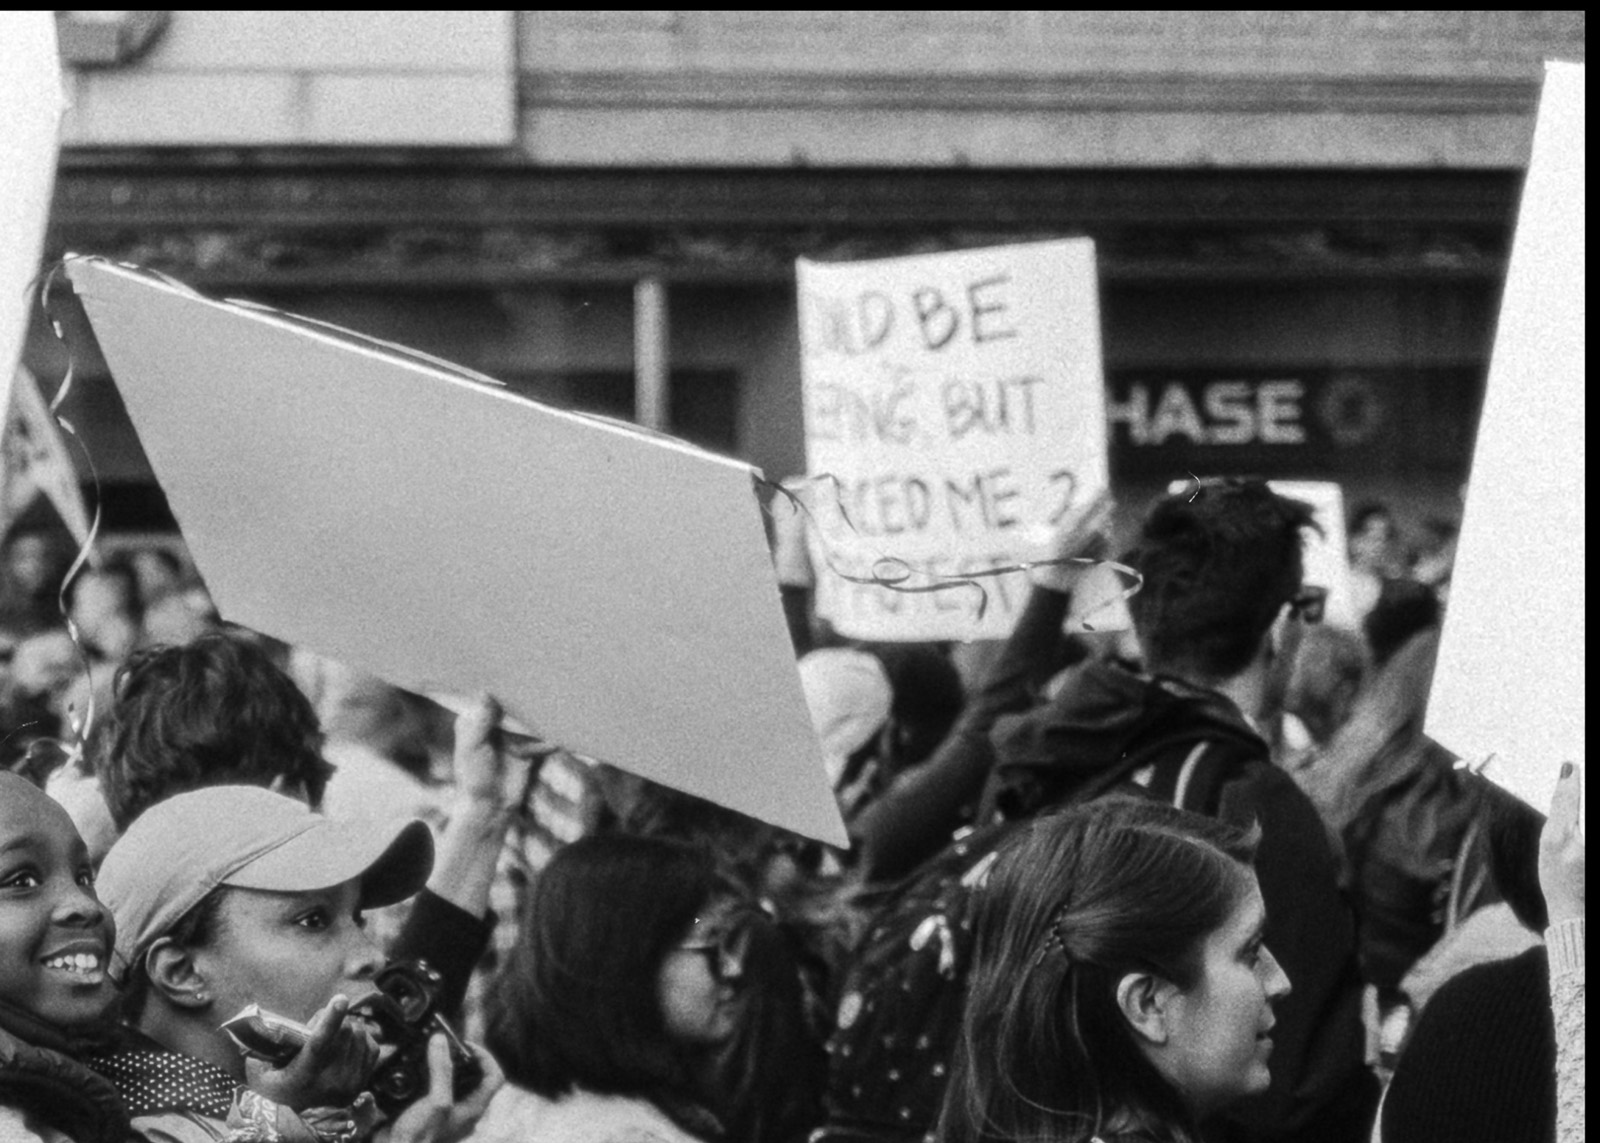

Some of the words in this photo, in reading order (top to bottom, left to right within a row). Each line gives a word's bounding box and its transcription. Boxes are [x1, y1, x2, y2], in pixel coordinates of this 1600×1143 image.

[912, 273, 1017, 352] BE
[943, 376, 1045, 440] BUT
[945, 469, 1020, 533] ME
